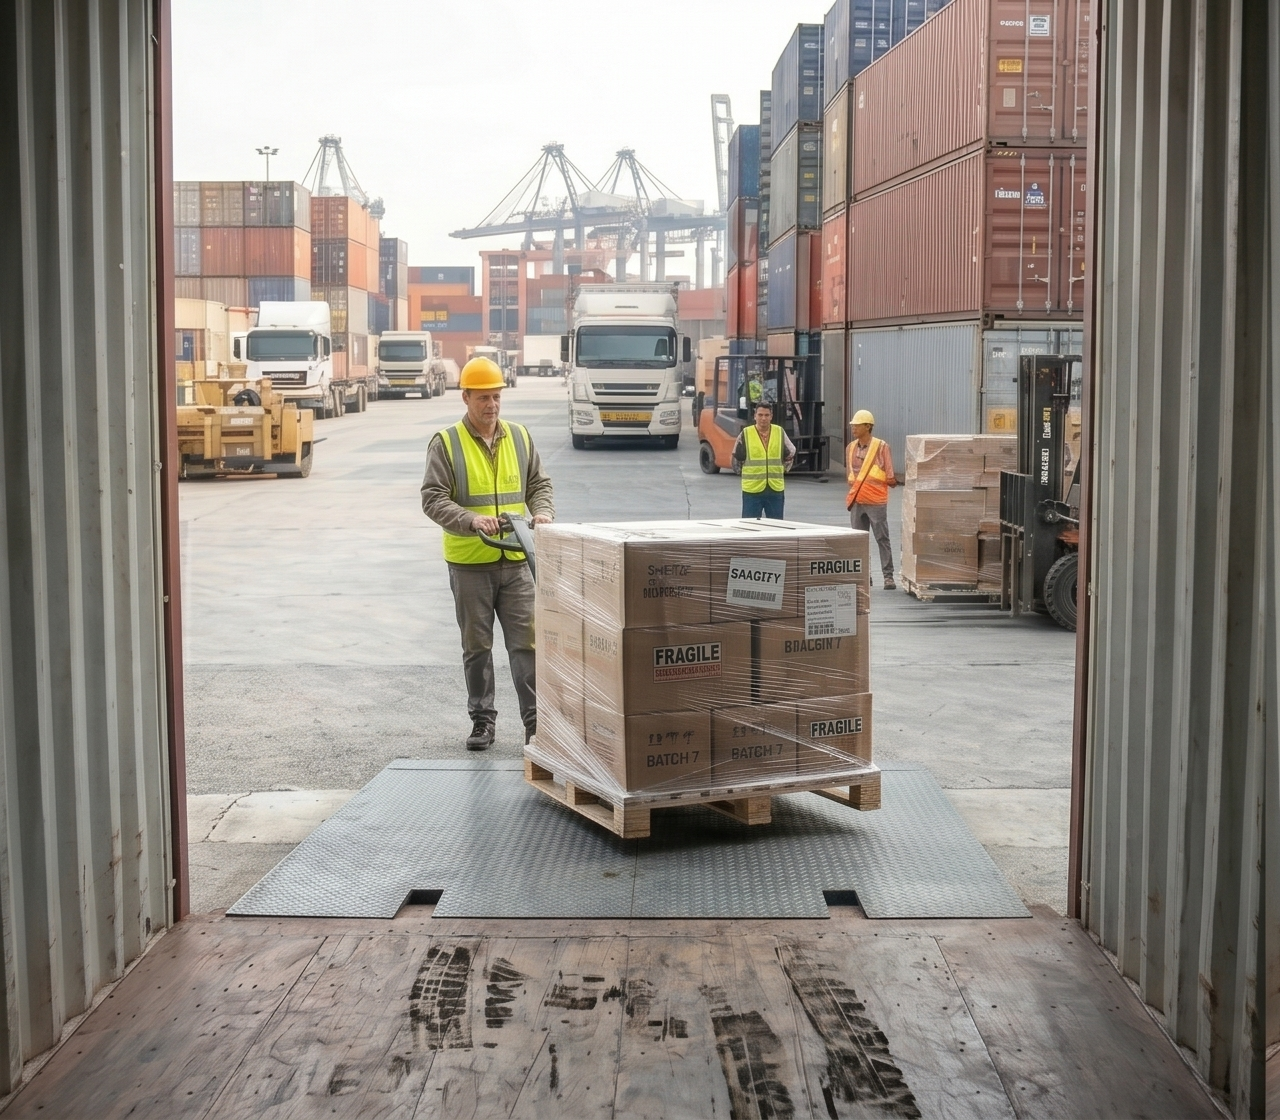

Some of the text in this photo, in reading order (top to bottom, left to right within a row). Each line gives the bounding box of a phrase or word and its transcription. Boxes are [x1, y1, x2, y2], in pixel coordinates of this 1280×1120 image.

[810, 559, 861, 576] FRAGILE
[655, 644, 720, 666] FRAGILE
[811, 718, 862, 737] FRAGILE
[646, 751, 700, 768] BATCH 7
[731, 743, 783, 760] BATCH 7
